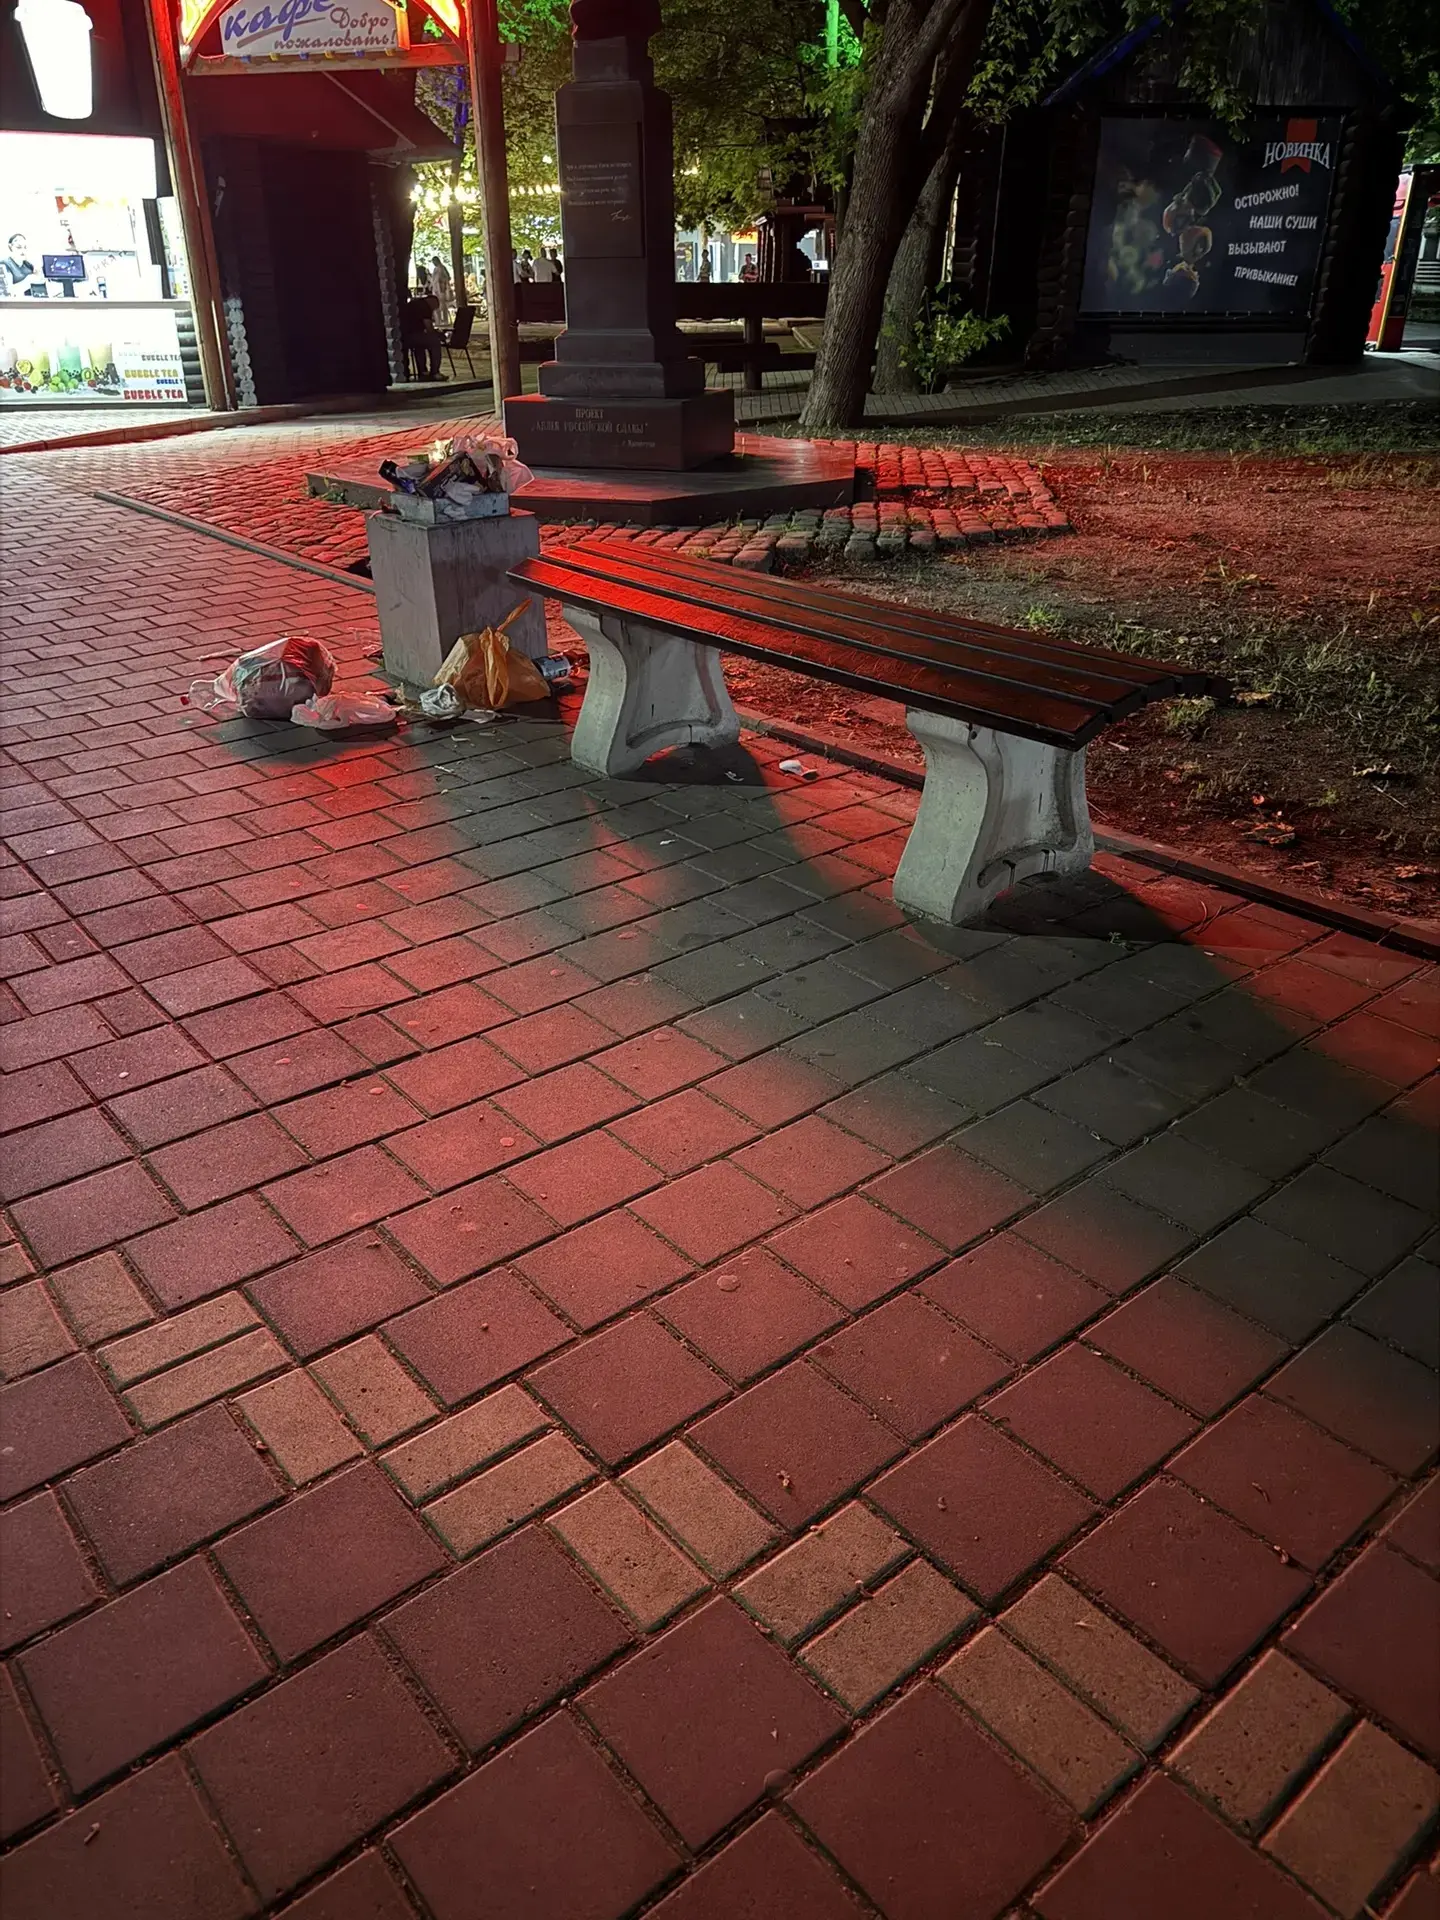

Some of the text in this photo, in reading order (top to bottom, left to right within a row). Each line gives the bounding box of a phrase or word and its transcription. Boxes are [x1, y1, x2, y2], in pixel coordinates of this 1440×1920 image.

[329, 7, 390, 35] Добро
[274, 29, 397, 50] пожаловать!
[1262, 142, 1330, 169] НОВИНКА
[1234, 184, 1300, 210] ОСТОРОЖНО!
[1249, 215, 1318, 230] НАШИ СУШИ
[1228, 240, 1287, 255] ВЫЗЫВАЮТ
[1234, 266, 1299, 286] ПРИВЫКАНИЕ!
[124, 368, 179, 378] BUBBLE TEA
[123, 389, 184, 400] BUBBLE TEA
[575, 408, 604, 419] ПРОЕКТ
